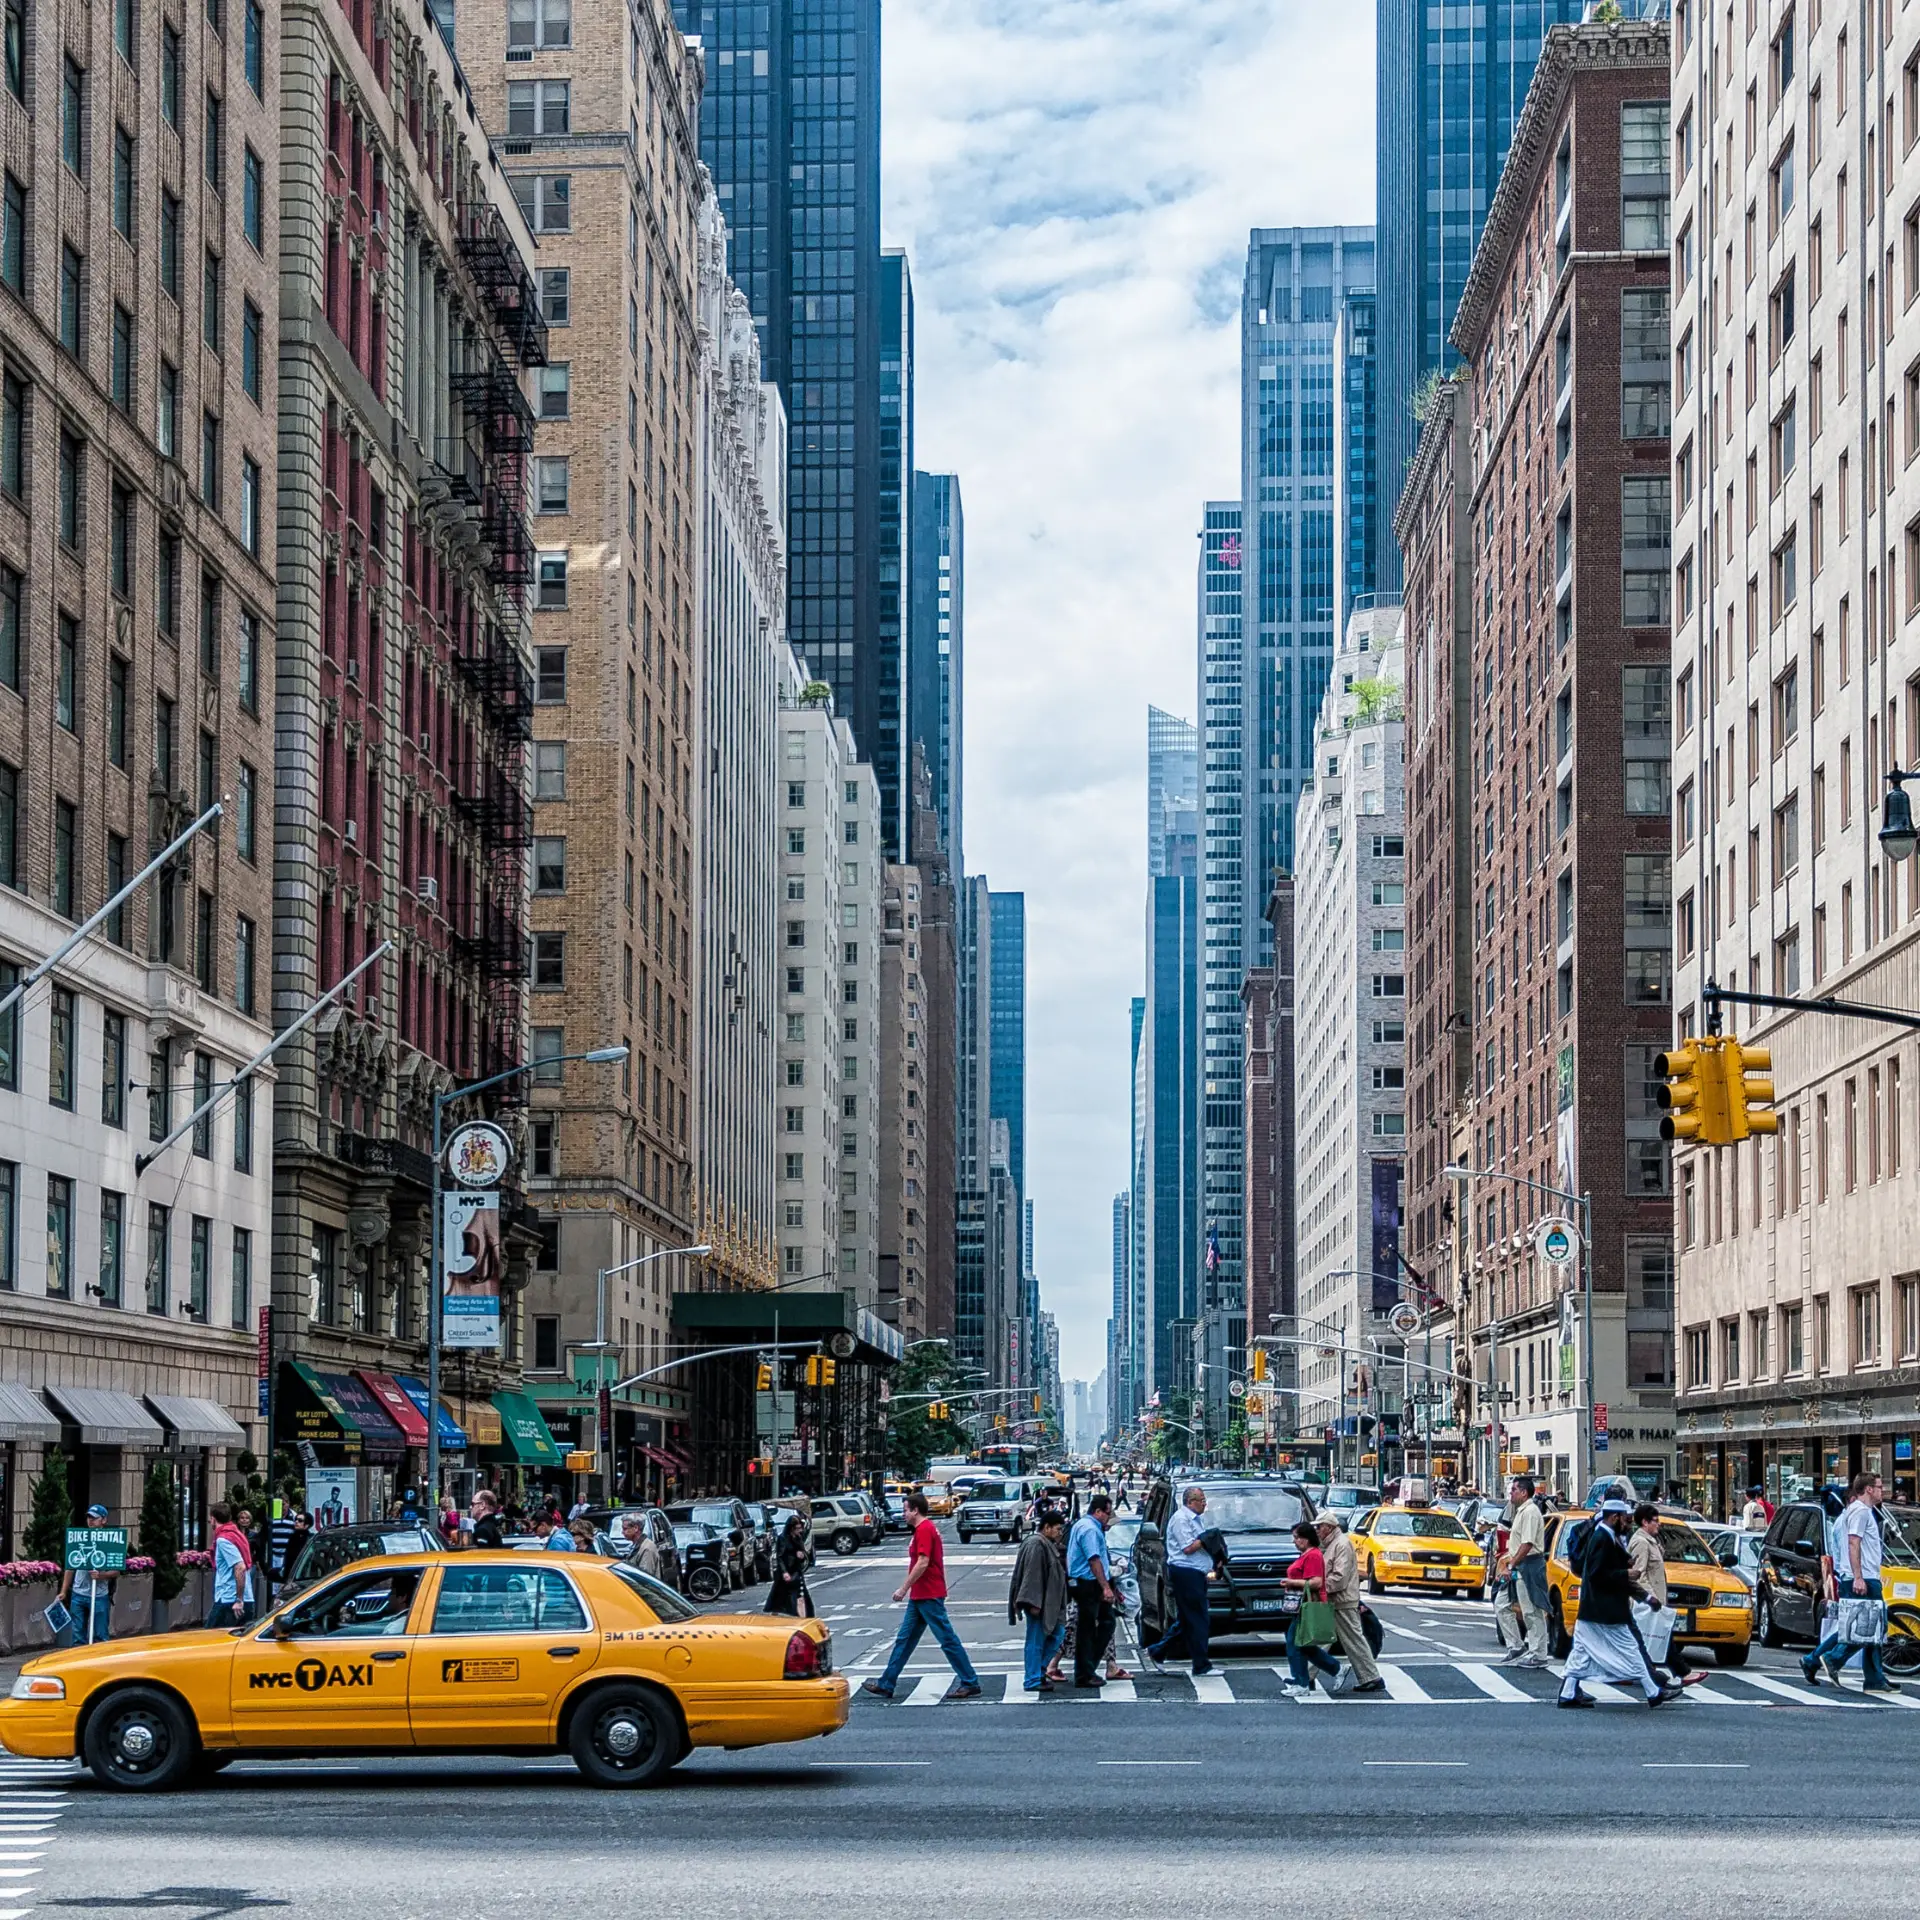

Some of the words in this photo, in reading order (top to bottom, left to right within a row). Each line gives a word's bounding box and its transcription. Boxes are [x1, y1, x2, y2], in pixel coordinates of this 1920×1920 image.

[459, 1197, 485, 1206] NYC
[546, 1422, 570, 1431] PARK
[1584, 1423, 1635, 1439] DSOR
[68, 1531, 88, 1544] BIKE
[91, 1531, 124, 1544] RENTAL
[249, 1672, 293, 1688] NYC
[297, 1660, 373, 1689] TAXI
